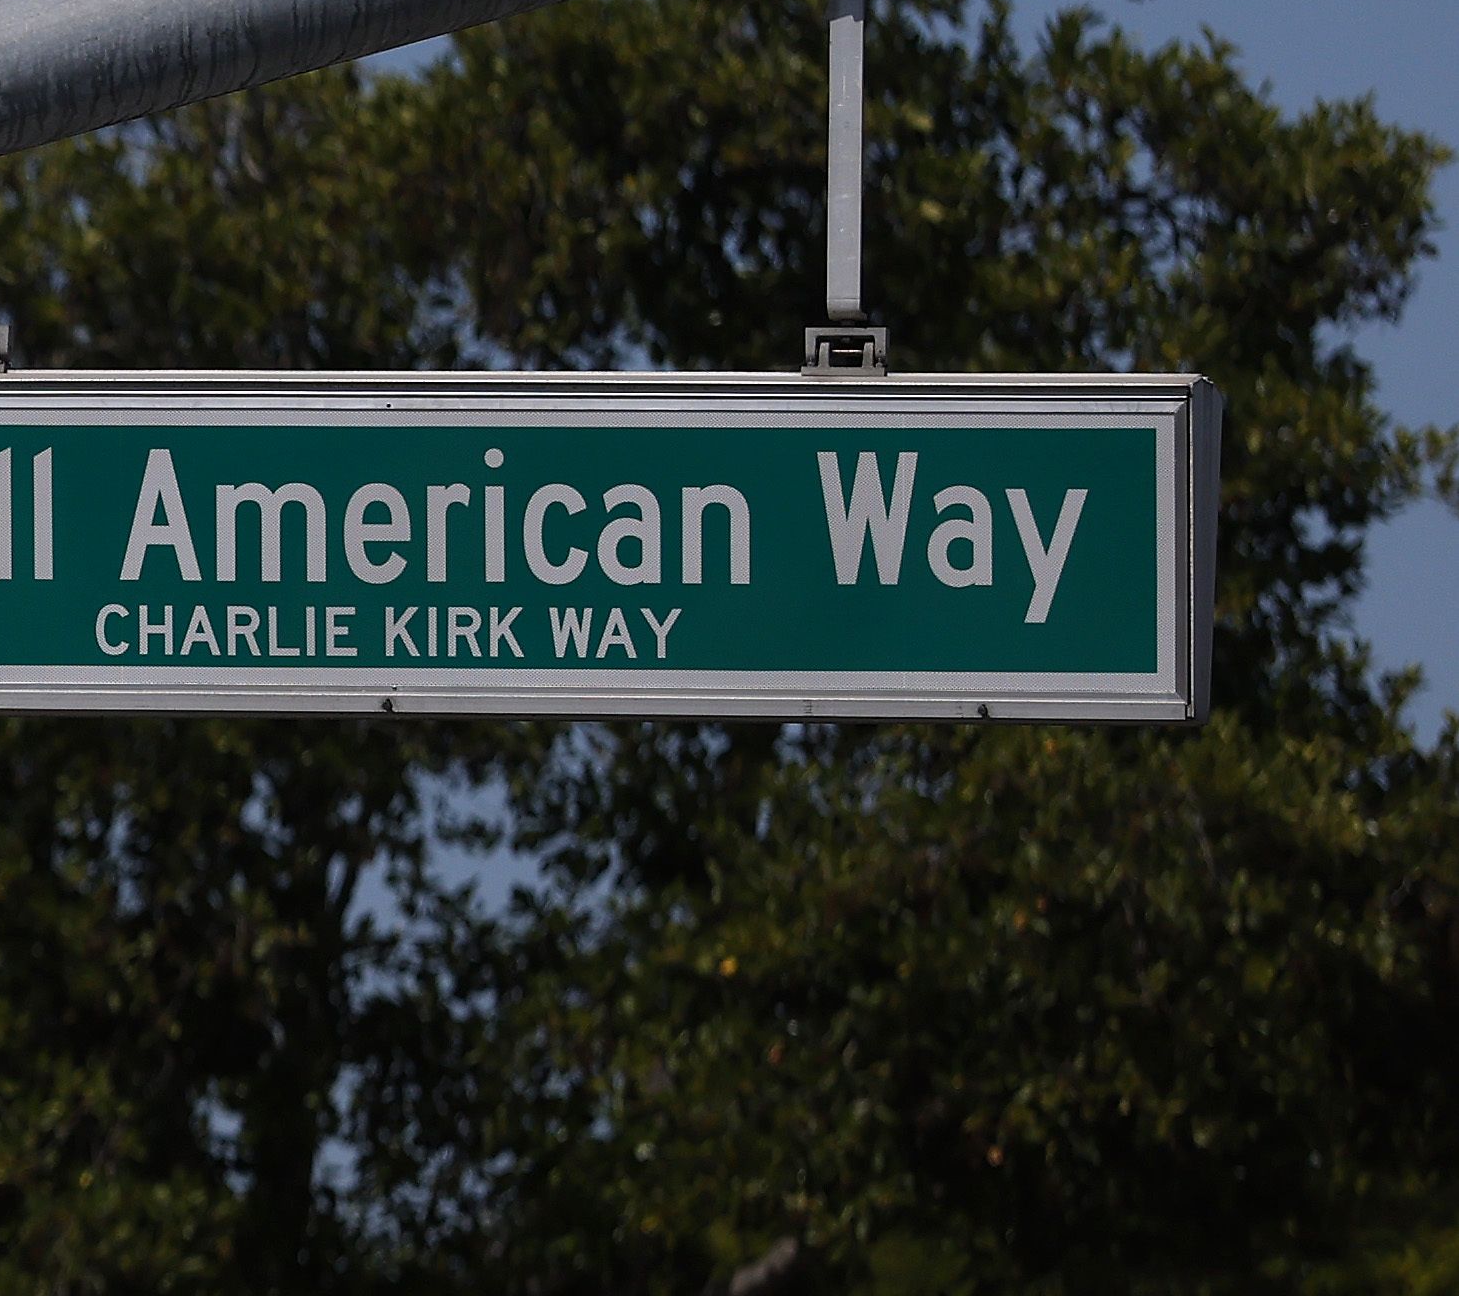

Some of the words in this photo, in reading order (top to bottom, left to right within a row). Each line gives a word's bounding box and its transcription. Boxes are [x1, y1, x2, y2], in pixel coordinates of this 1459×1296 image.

[120, 449, 751, 586] American
[817, 452, 1088, 623] Way
[95, 603, 356, 657] CHARLIE
[385, 606, 523, 658] KIRK
[548, 607, 682, 659] WAY
